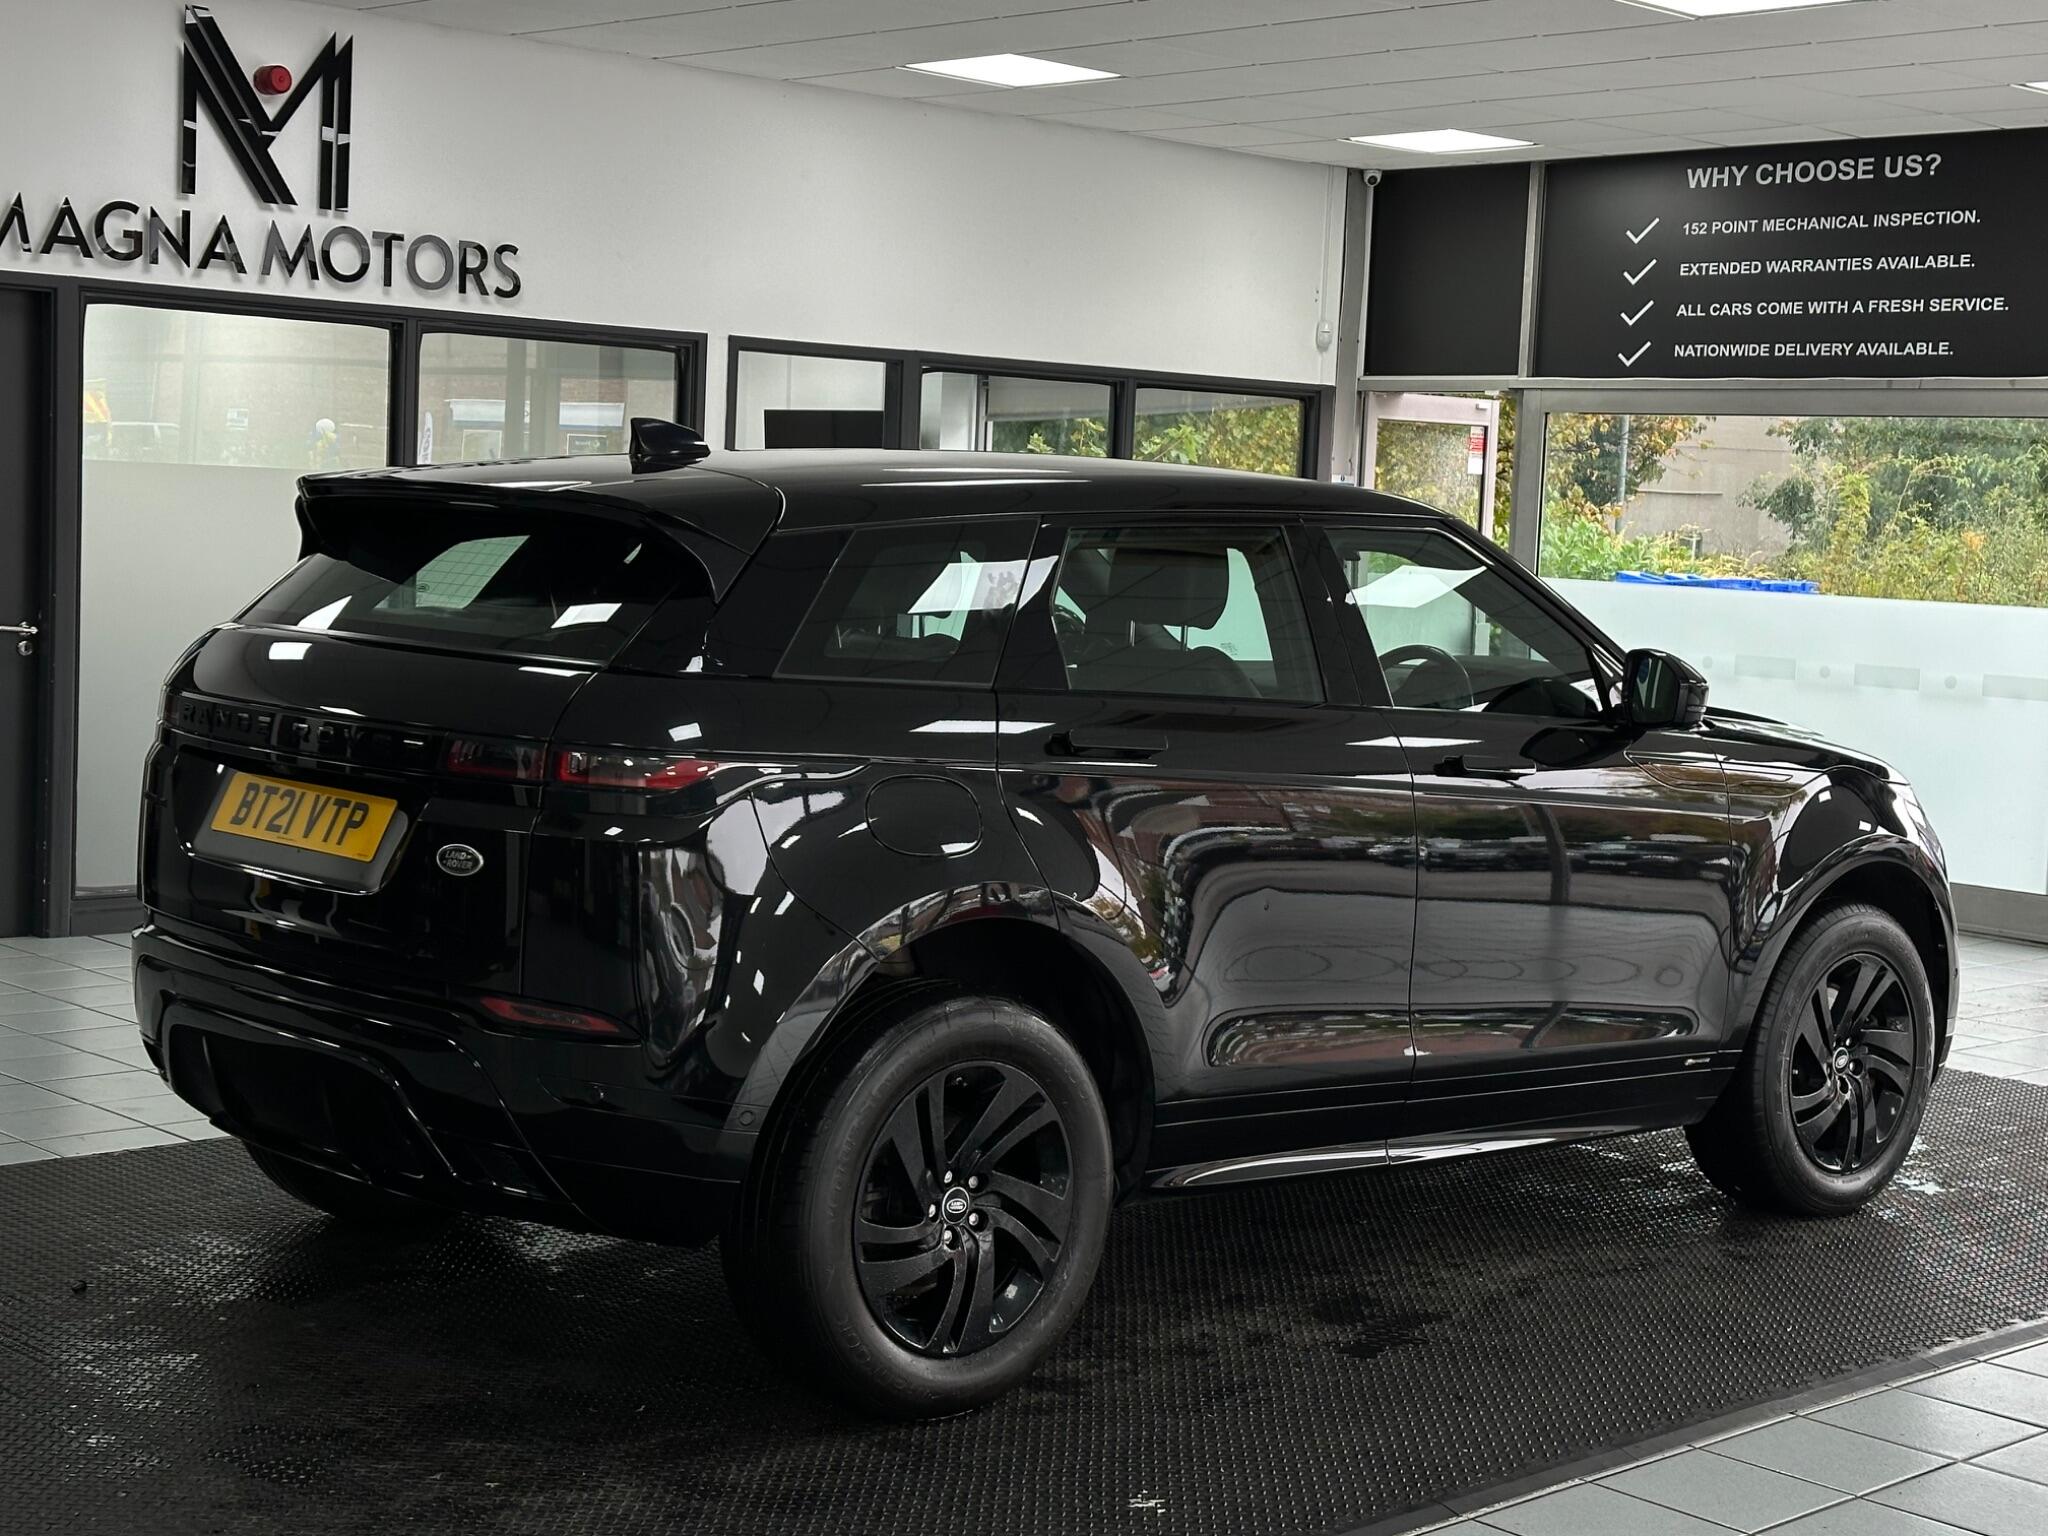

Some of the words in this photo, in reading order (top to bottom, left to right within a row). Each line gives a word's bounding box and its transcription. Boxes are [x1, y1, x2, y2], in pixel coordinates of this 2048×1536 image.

[1687, 166, 1749, 189] WHY
[1755, 157, 1875, 185] CHOOSE
[1884, 153, 1942, 178] US?
[1682, 221, 1708, 236] 152
[1711, 219, 1759, 235] POINT
[1762, 213, 1869, 232] MECHANICAL
[1873, 209, 1981, 228] INSPECTION.
[261, 219, 521, 299] MOTORS
[1679, 261, 1762, 277] EXTENDED
[1765, 257, 1873, 274] WARRANTIES
[1875, 253, 1976, 271] AVAILABLE.
[1675, 303, 1706, 317] ALL
[1709, 302, 1753, 317] CARS
[1756, 301, 1804, 316] COME
[1807, 300, 1849, 315] WITH
[1851, 300, 1865, 314] A
[1868, 298, 1925, 314] FRESH
[1928, 296, 2009, 313] SERVICE.
[1674, 343, 1771, 358] NATIONWIDE
[1774, 342, 1854, 357] DELIVERY
[1855, 341, 1954, 357] AVAILABLE.
